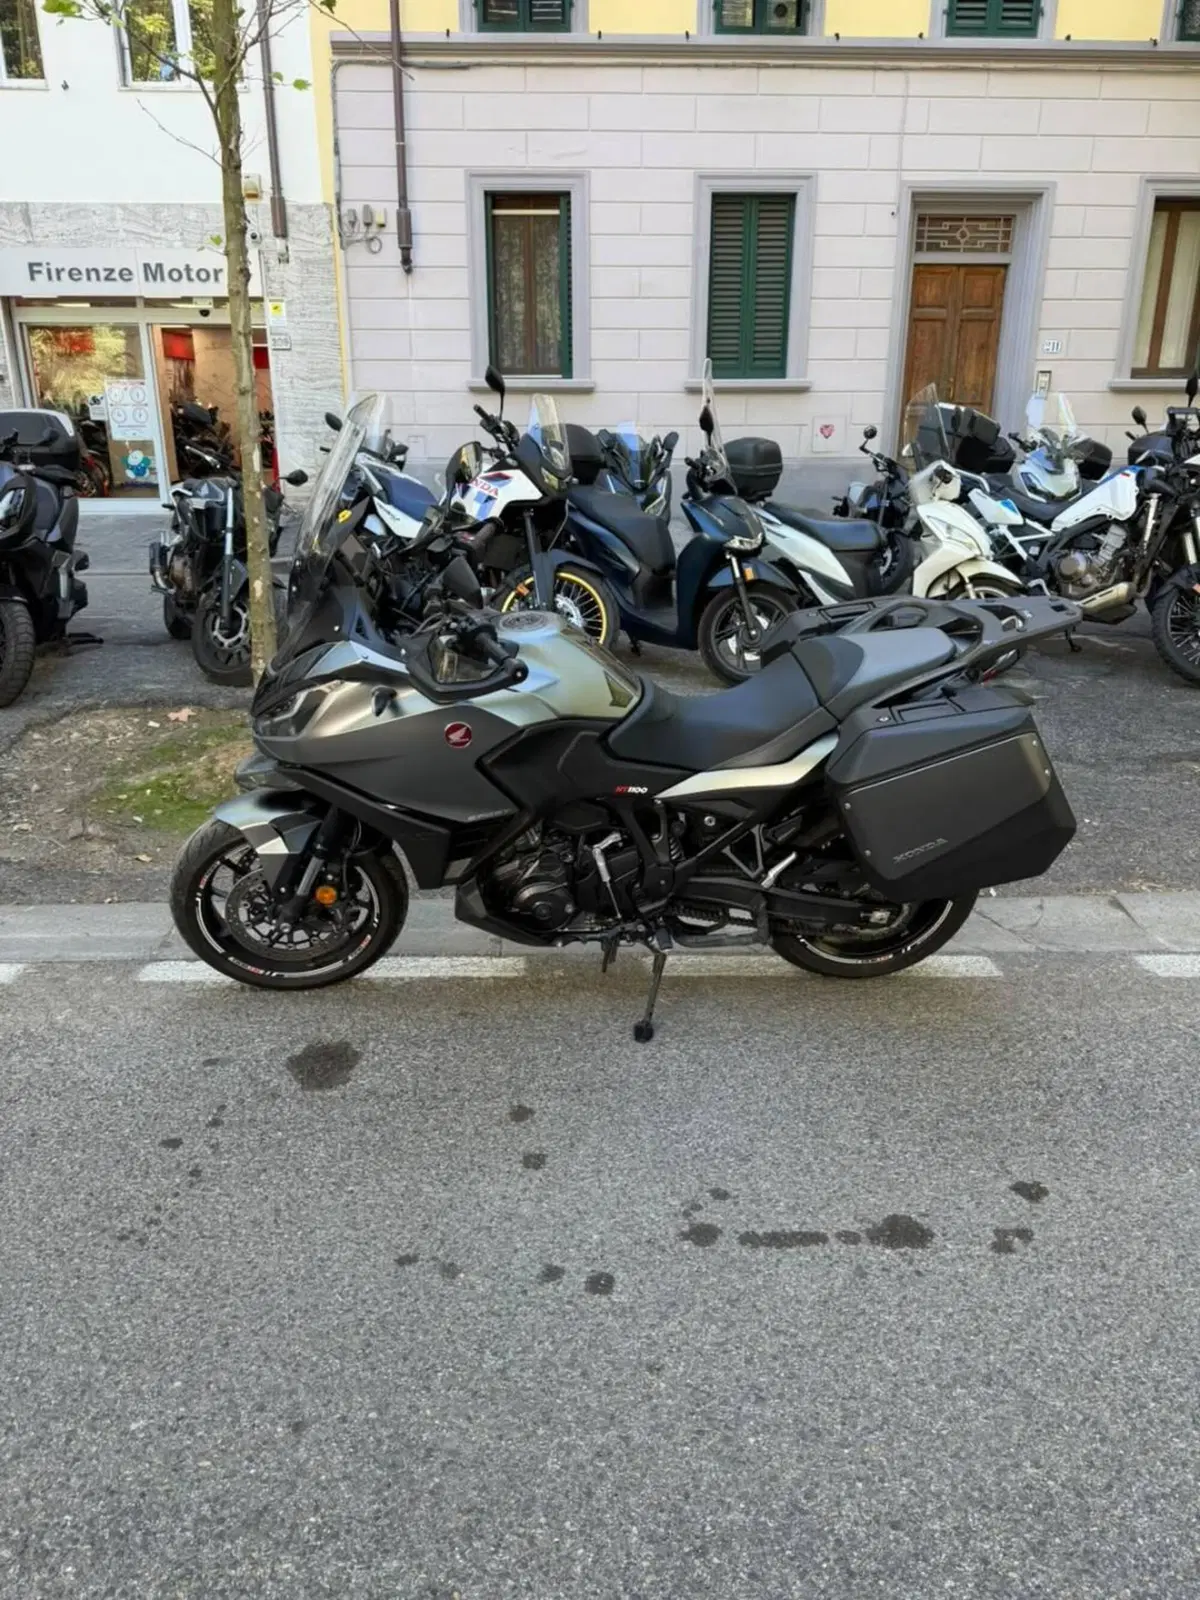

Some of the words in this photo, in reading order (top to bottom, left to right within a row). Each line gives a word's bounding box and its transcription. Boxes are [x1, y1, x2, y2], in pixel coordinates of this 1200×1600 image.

[27, 262, 134, 283] Firenze
[142, 262, 224, 283] Motor
[469, 478, 499, 497] NDA
